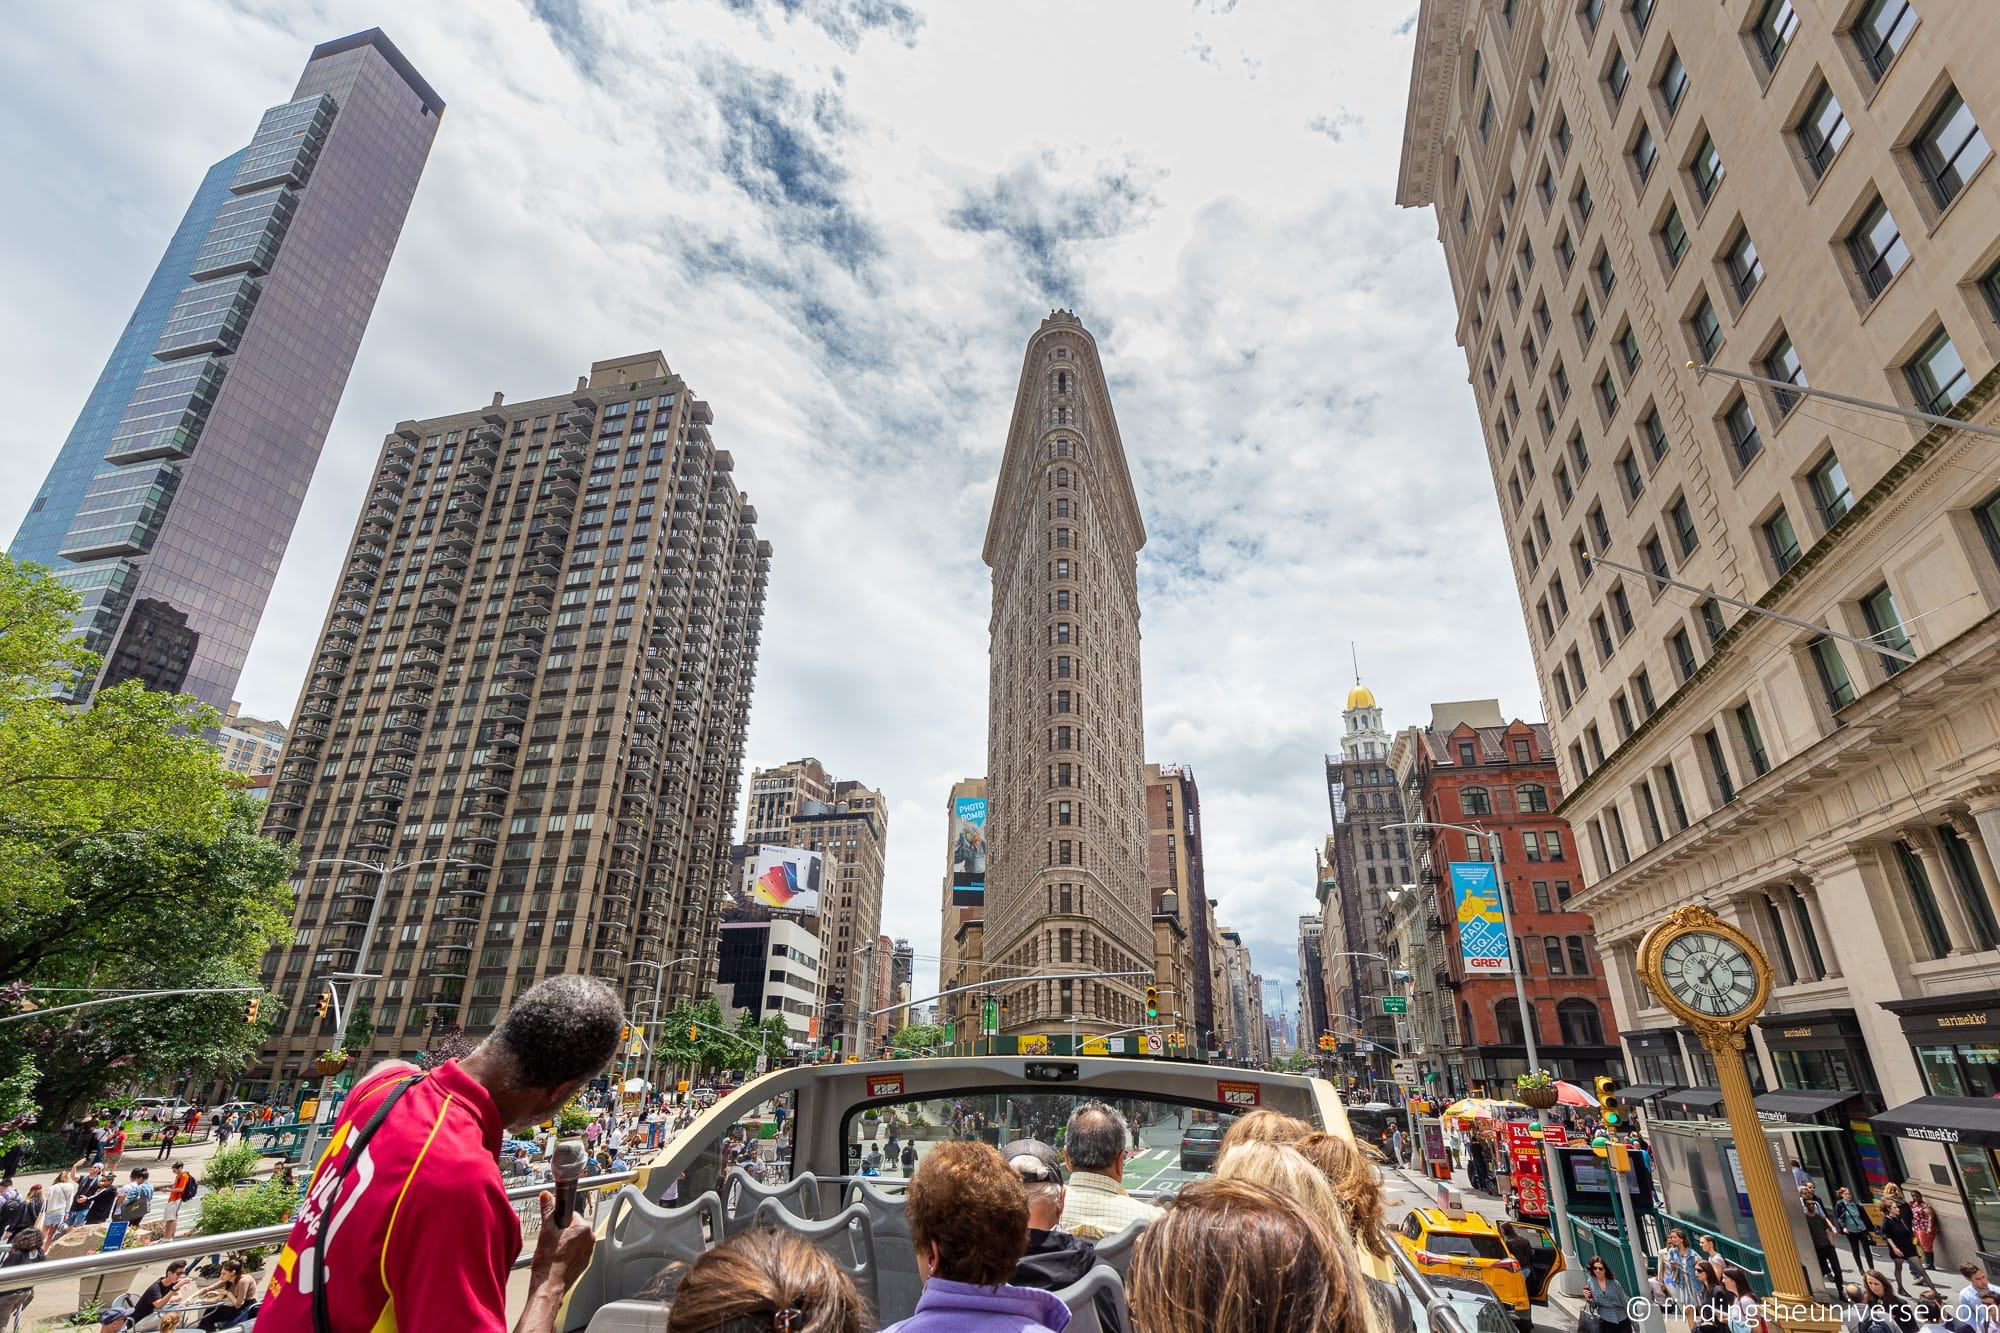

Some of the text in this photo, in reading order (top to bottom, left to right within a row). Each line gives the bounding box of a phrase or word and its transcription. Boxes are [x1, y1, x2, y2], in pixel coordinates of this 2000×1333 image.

[960, 801, 985, 814] PHOTO
[961, 809, 986, 822] BOMB!
[1461, 920, 1486, 944] MAD.
[1471, 937, 1491, 953] SQ.
[1471, 958, 1503, 967] GREY
[1684, 955, 1698, 975] FIFTH
[1937, 1013, 1988, 1027] marimekko
[1783, 1028, 1812, 1037] marimekko
[1905, 1126, 1959, 1143] marimekko
